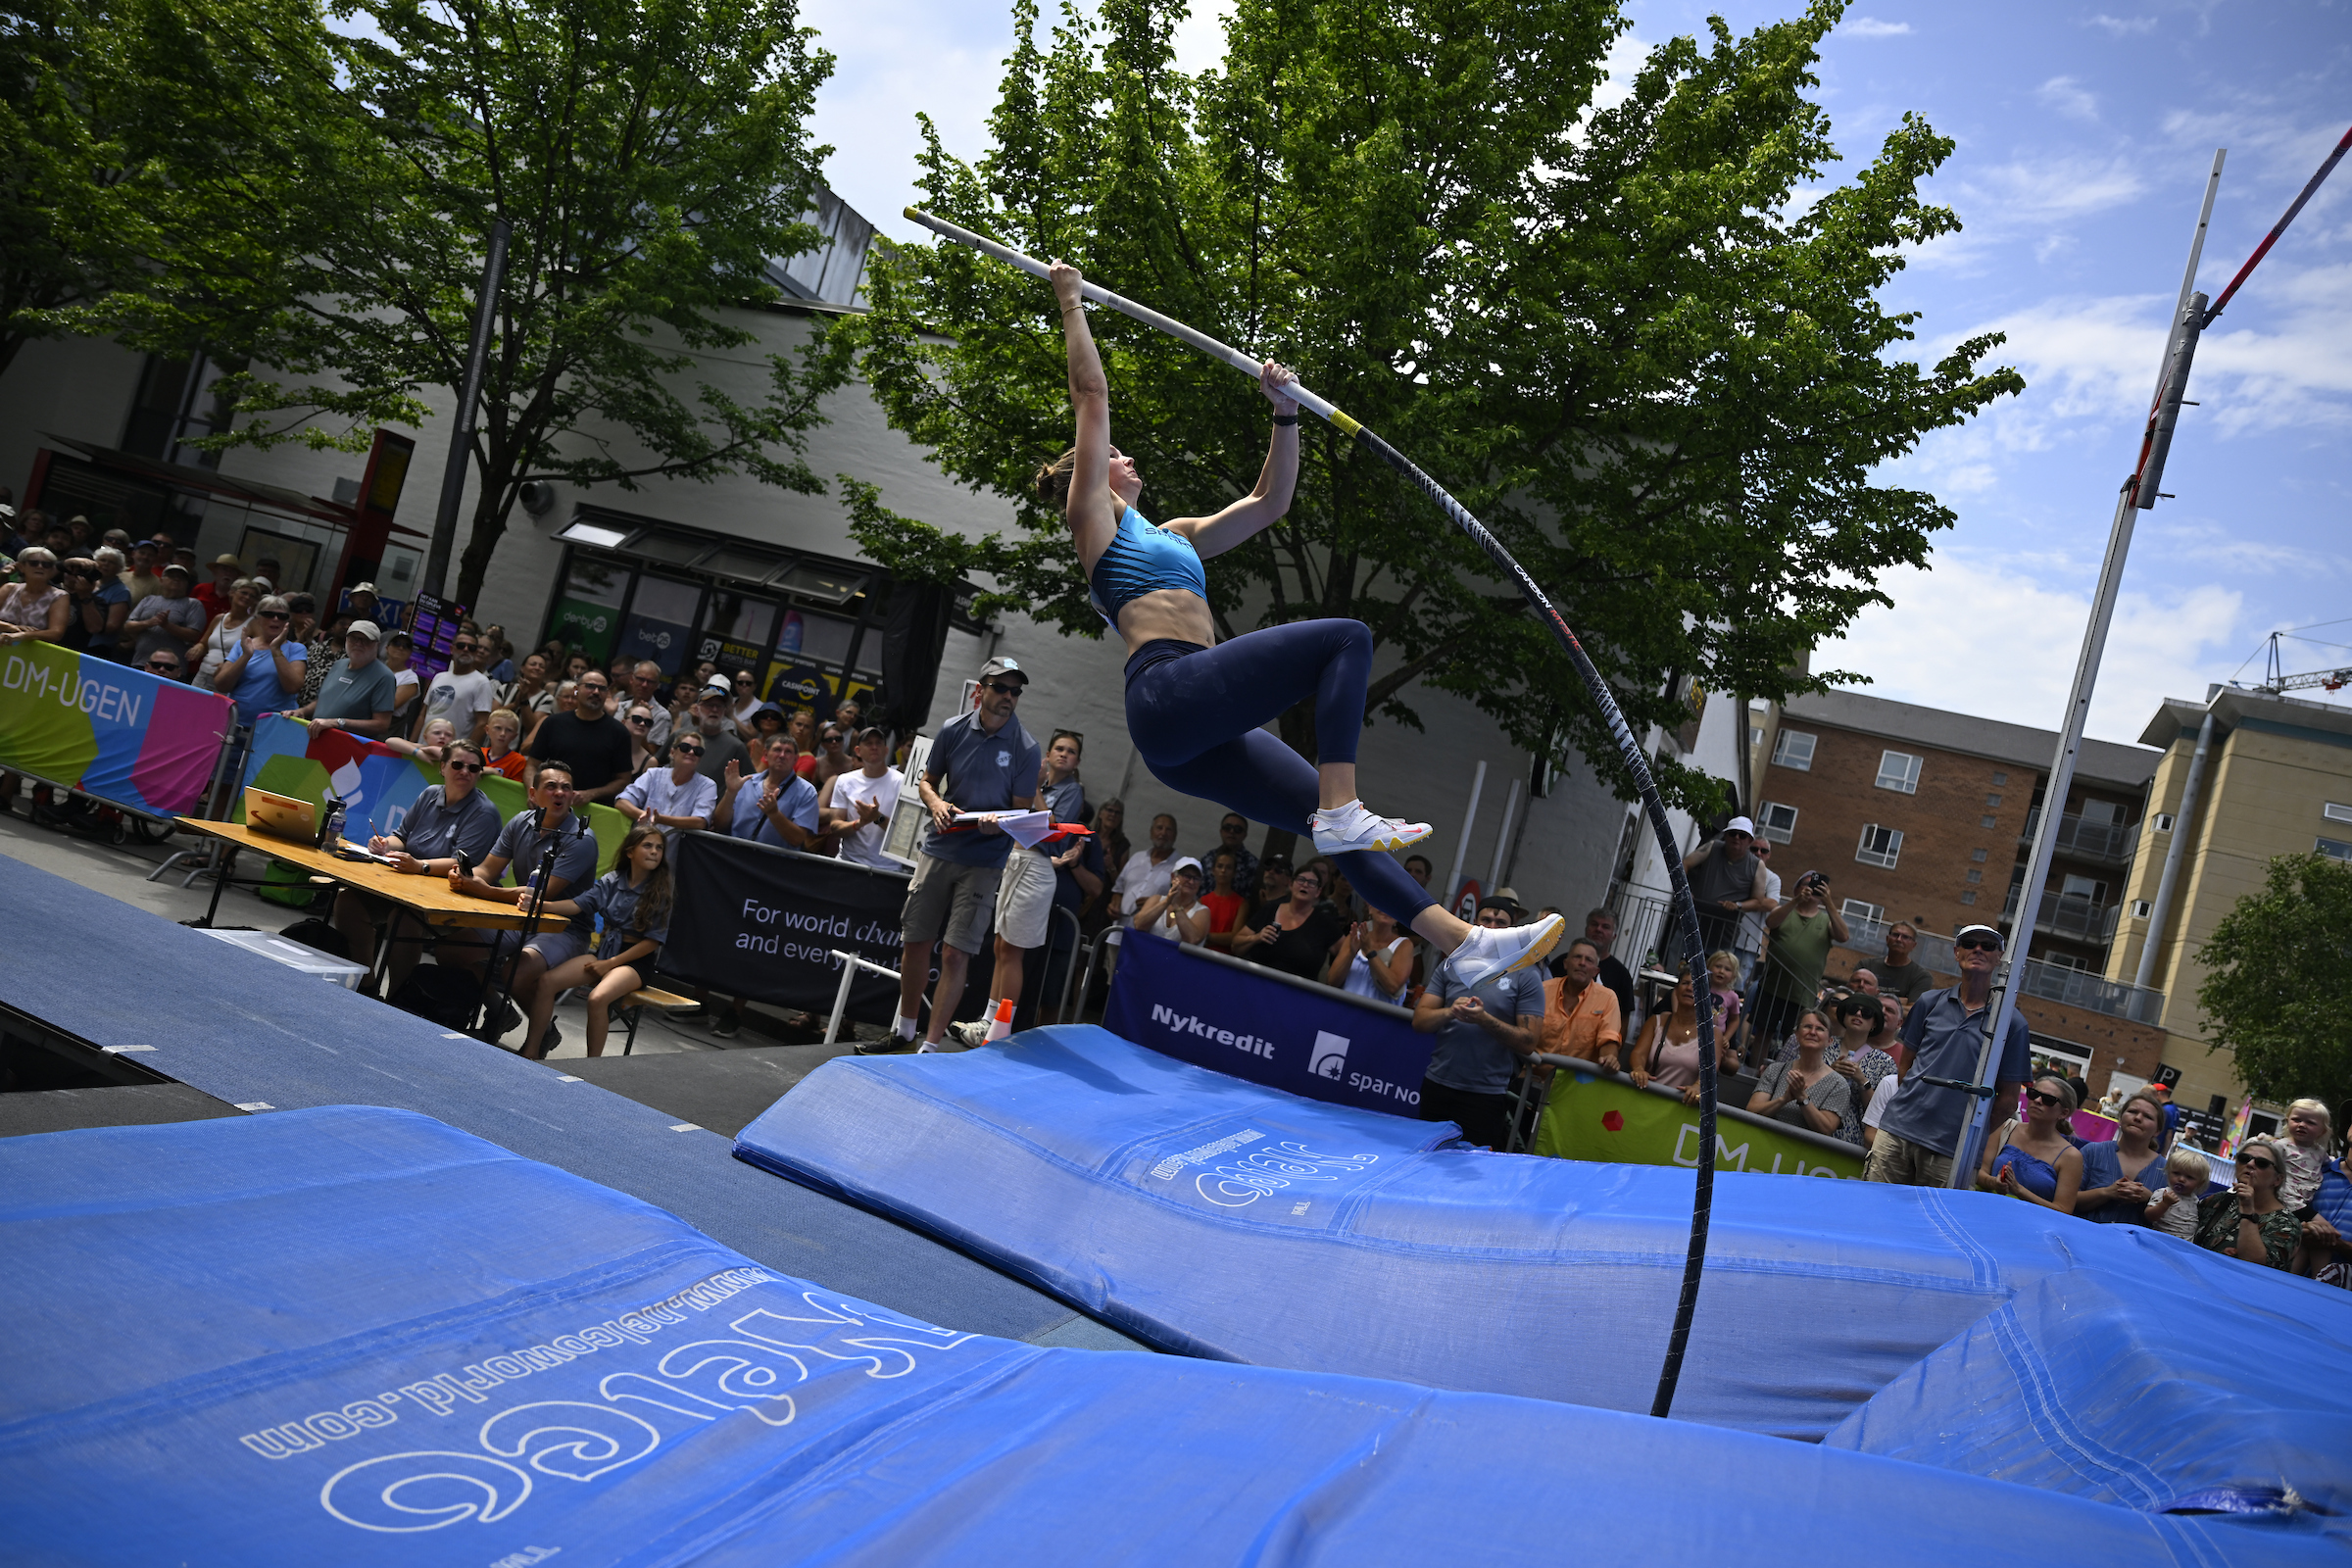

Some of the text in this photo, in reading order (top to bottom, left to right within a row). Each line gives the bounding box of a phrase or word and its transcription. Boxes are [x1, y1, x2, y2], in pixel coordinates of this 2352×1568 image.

[1513, 564, 1553, 609] CARBON
[638, 628, 671, 650] bet25
[722, 642, 759, 660] BETTER
[3, 655, 141, 727] DM-UGEN
[782, 680, 820, 696] CASHPOINT
[742, 899, 781, 924] For
[785, 910, 850, 940] world
[735, 932, 780, 955] and
[1152, 1003, 1275, 1060] Nykredit
[1348, 1069, 1421, 1106] spar NO
[2159, 1068, 2175, 1083] P
[239, 1266, 786, 1460] www.nelcoworld.com
